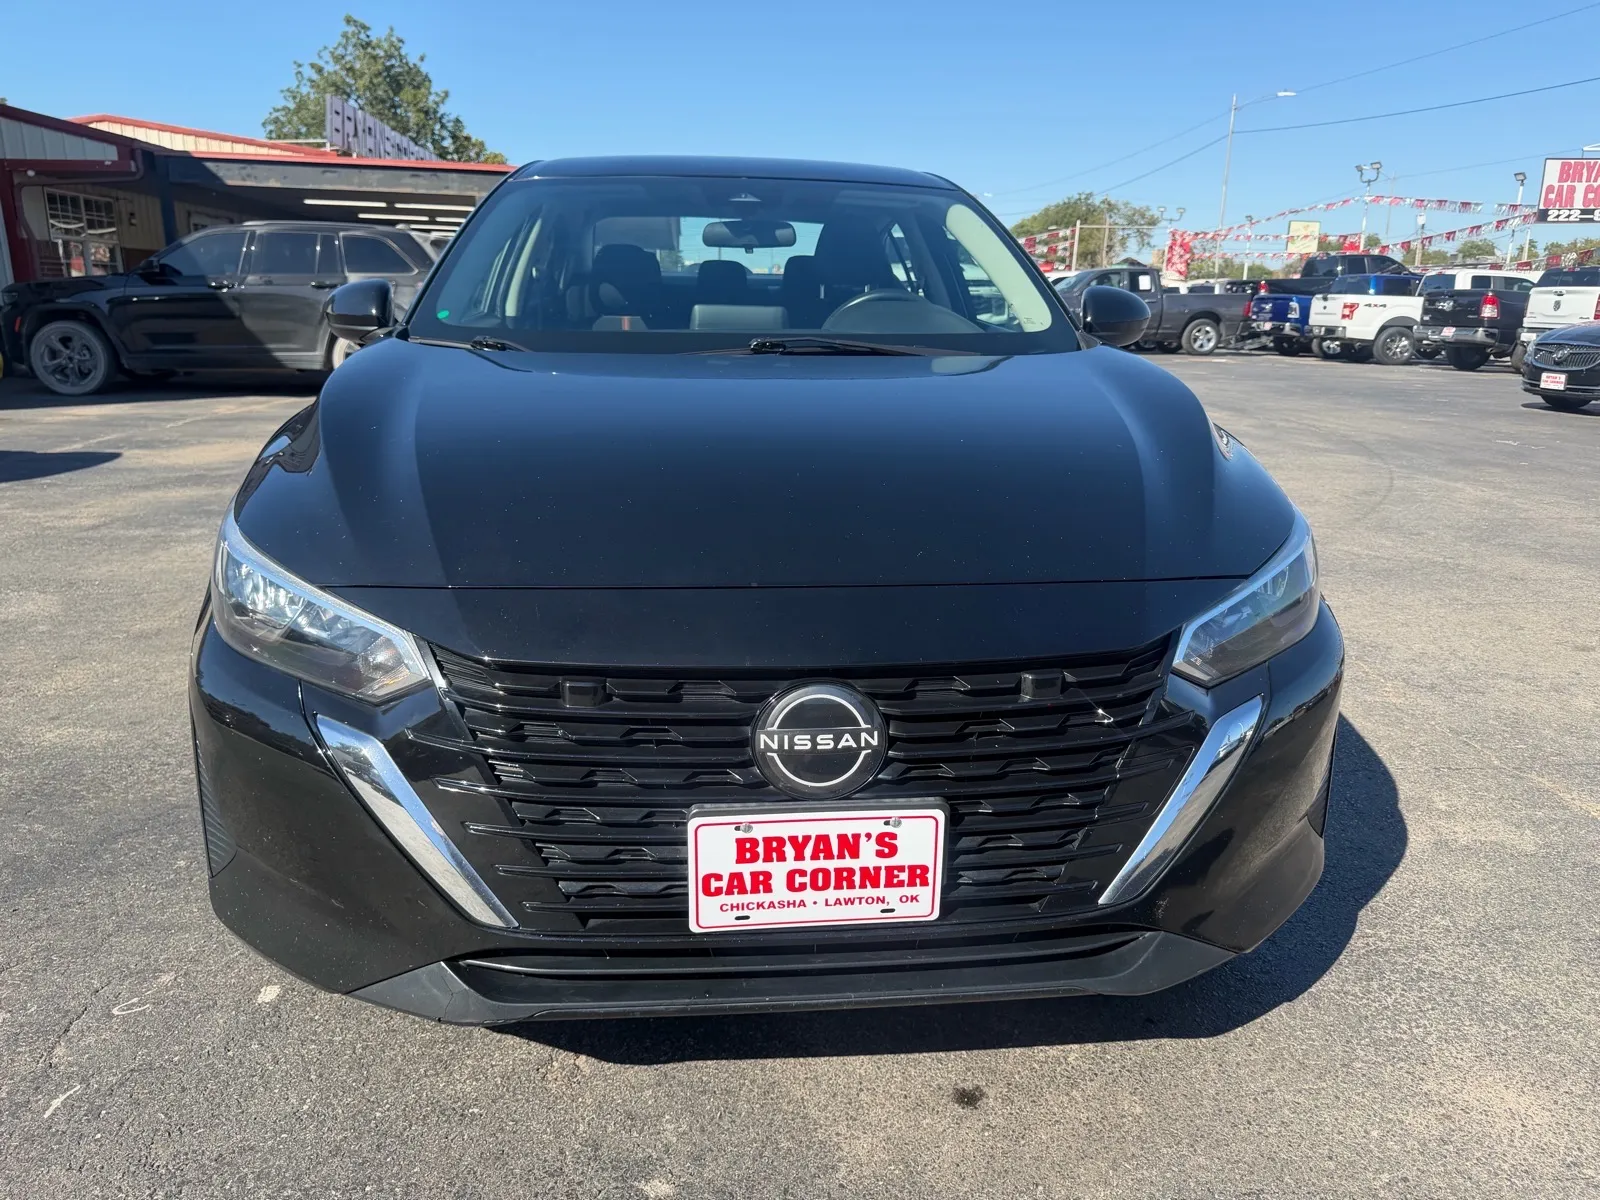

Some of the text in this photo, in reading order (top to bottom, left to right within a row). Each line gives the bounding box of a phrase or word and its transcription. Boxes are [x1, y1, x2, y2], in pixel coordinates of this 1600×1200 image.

[1543, 184, 1576, 208] CAR
[760, 731, 878, 750] NISSAN
[735, 832, 898, 864] BRYAN'S
[701, 864, 930, 897] CAR CORNER
[719, 894, 920, 913] CHICKASHA LAWTON, OK
